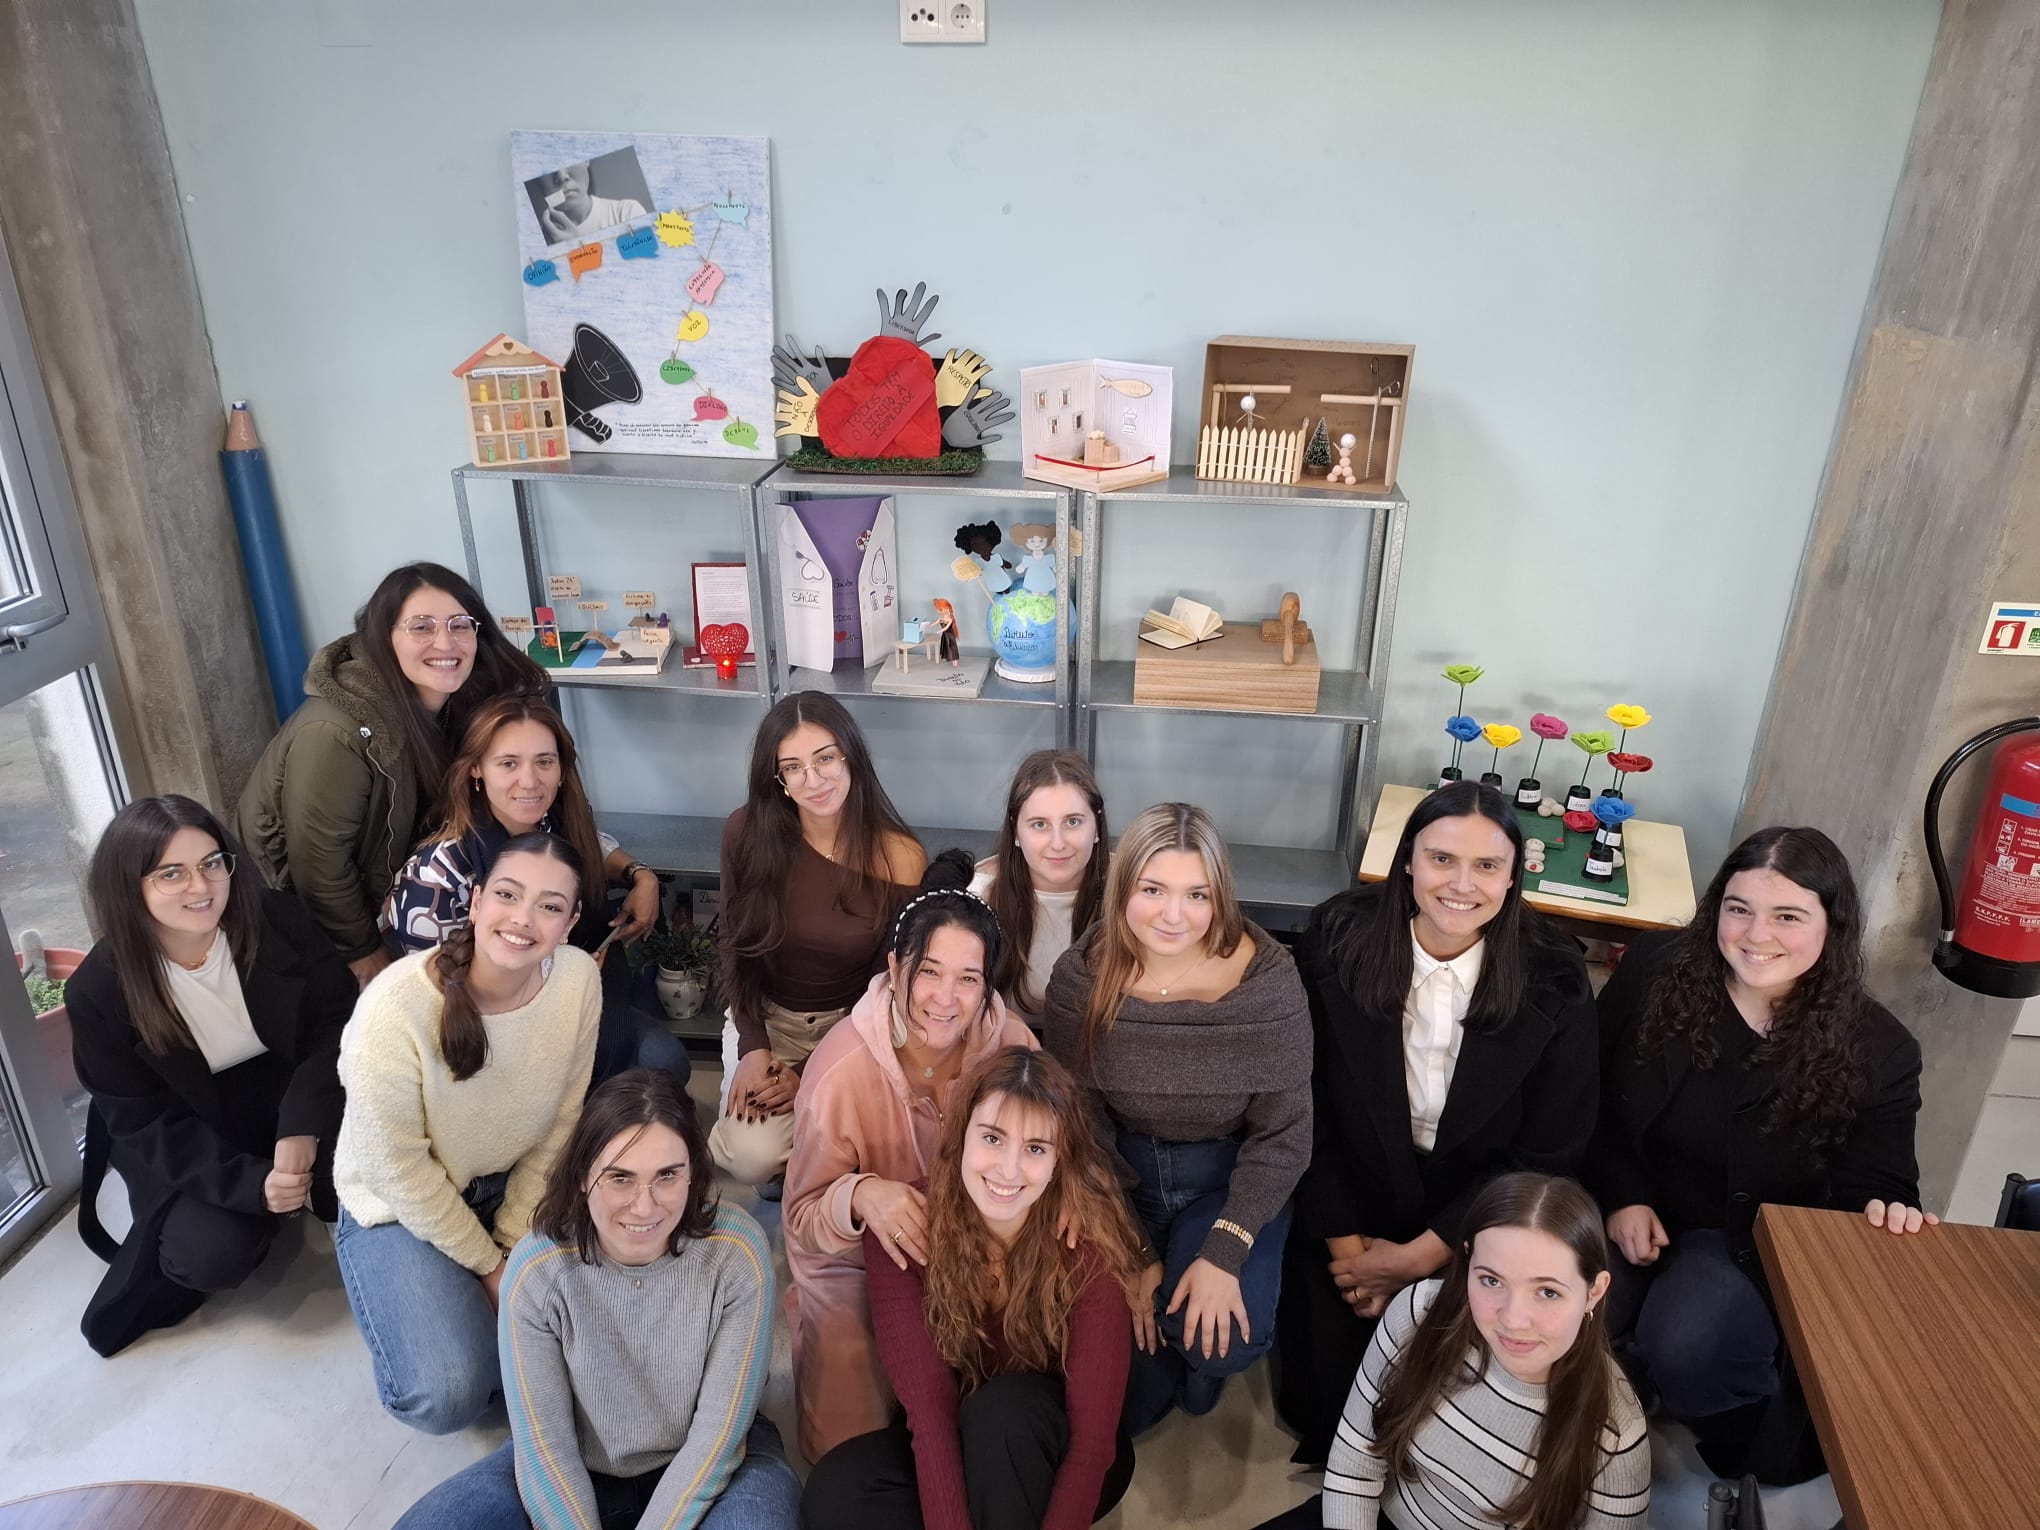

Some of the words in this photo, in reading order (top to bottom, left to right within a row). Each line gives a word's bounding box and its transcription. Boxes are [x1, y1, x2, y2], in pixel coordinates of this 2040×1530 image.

[687, 319, 702, 332] VOZ
[947, 365, 972, 389] RESPEITO
[791, 400, 804, 421] NÃO
[842, 394, 881, 428] TODOS
[851, 429, 864, 441] O
[862, 396, 896, 432] DIREITO
[870, 391, 915, 441] IGUALDADE
[791, 591, 820, 604] SAÚDE
